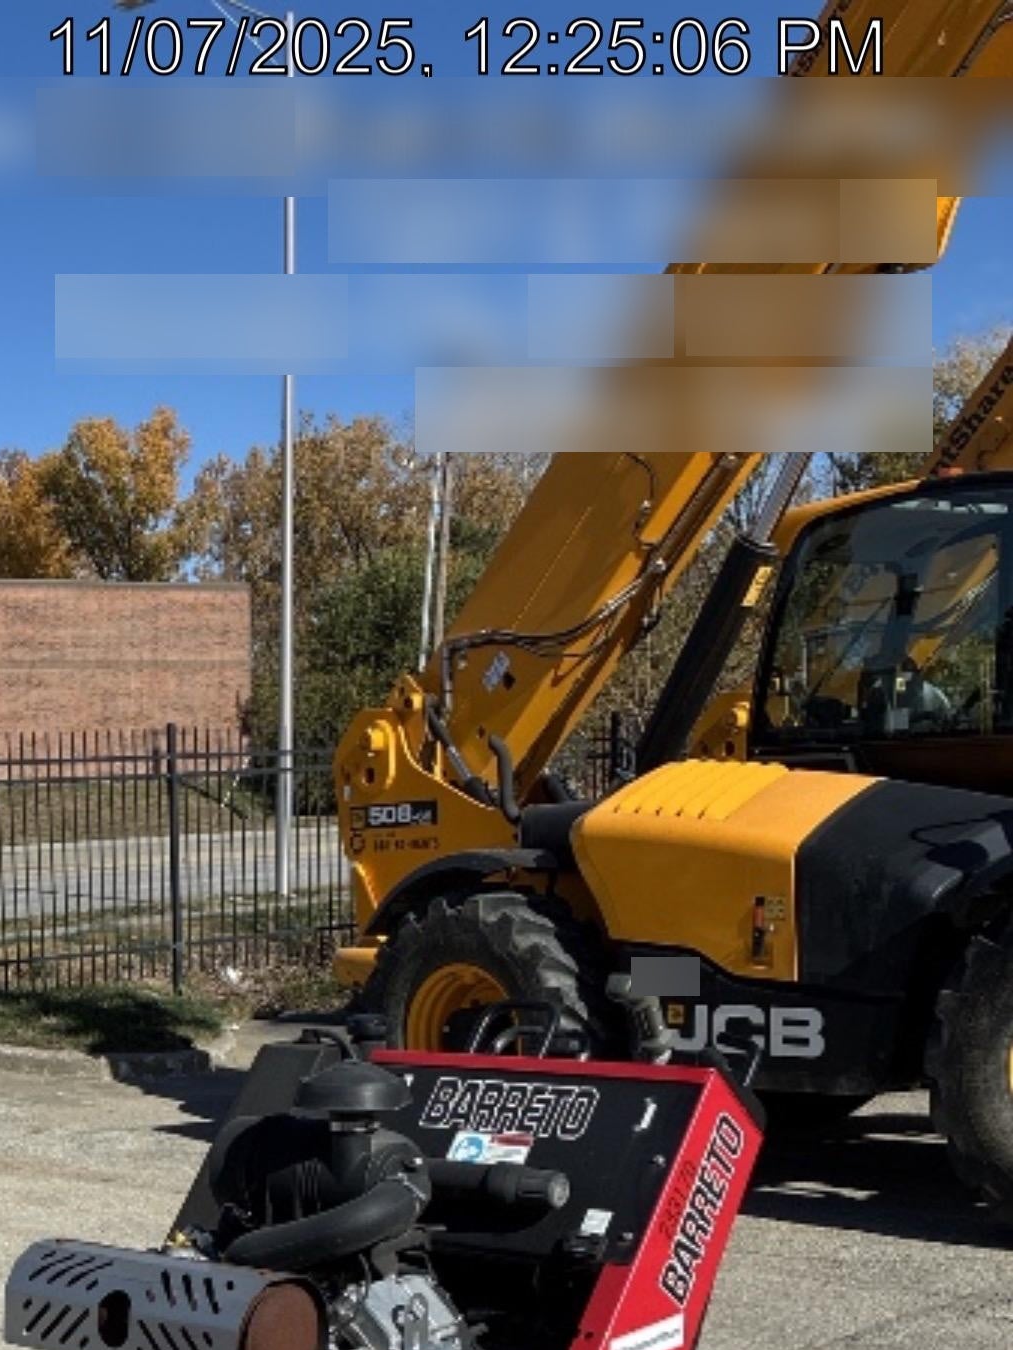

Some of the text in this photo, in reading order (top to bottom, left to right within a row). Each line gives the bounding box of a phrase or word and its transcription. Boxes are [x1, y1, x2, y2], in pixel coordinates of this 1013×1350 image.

[665, 1004, 825, 1057] JCB
[419, 1077, 600, 1141] BARRETO
[659, 1111, 744, 1308] BARRETO
